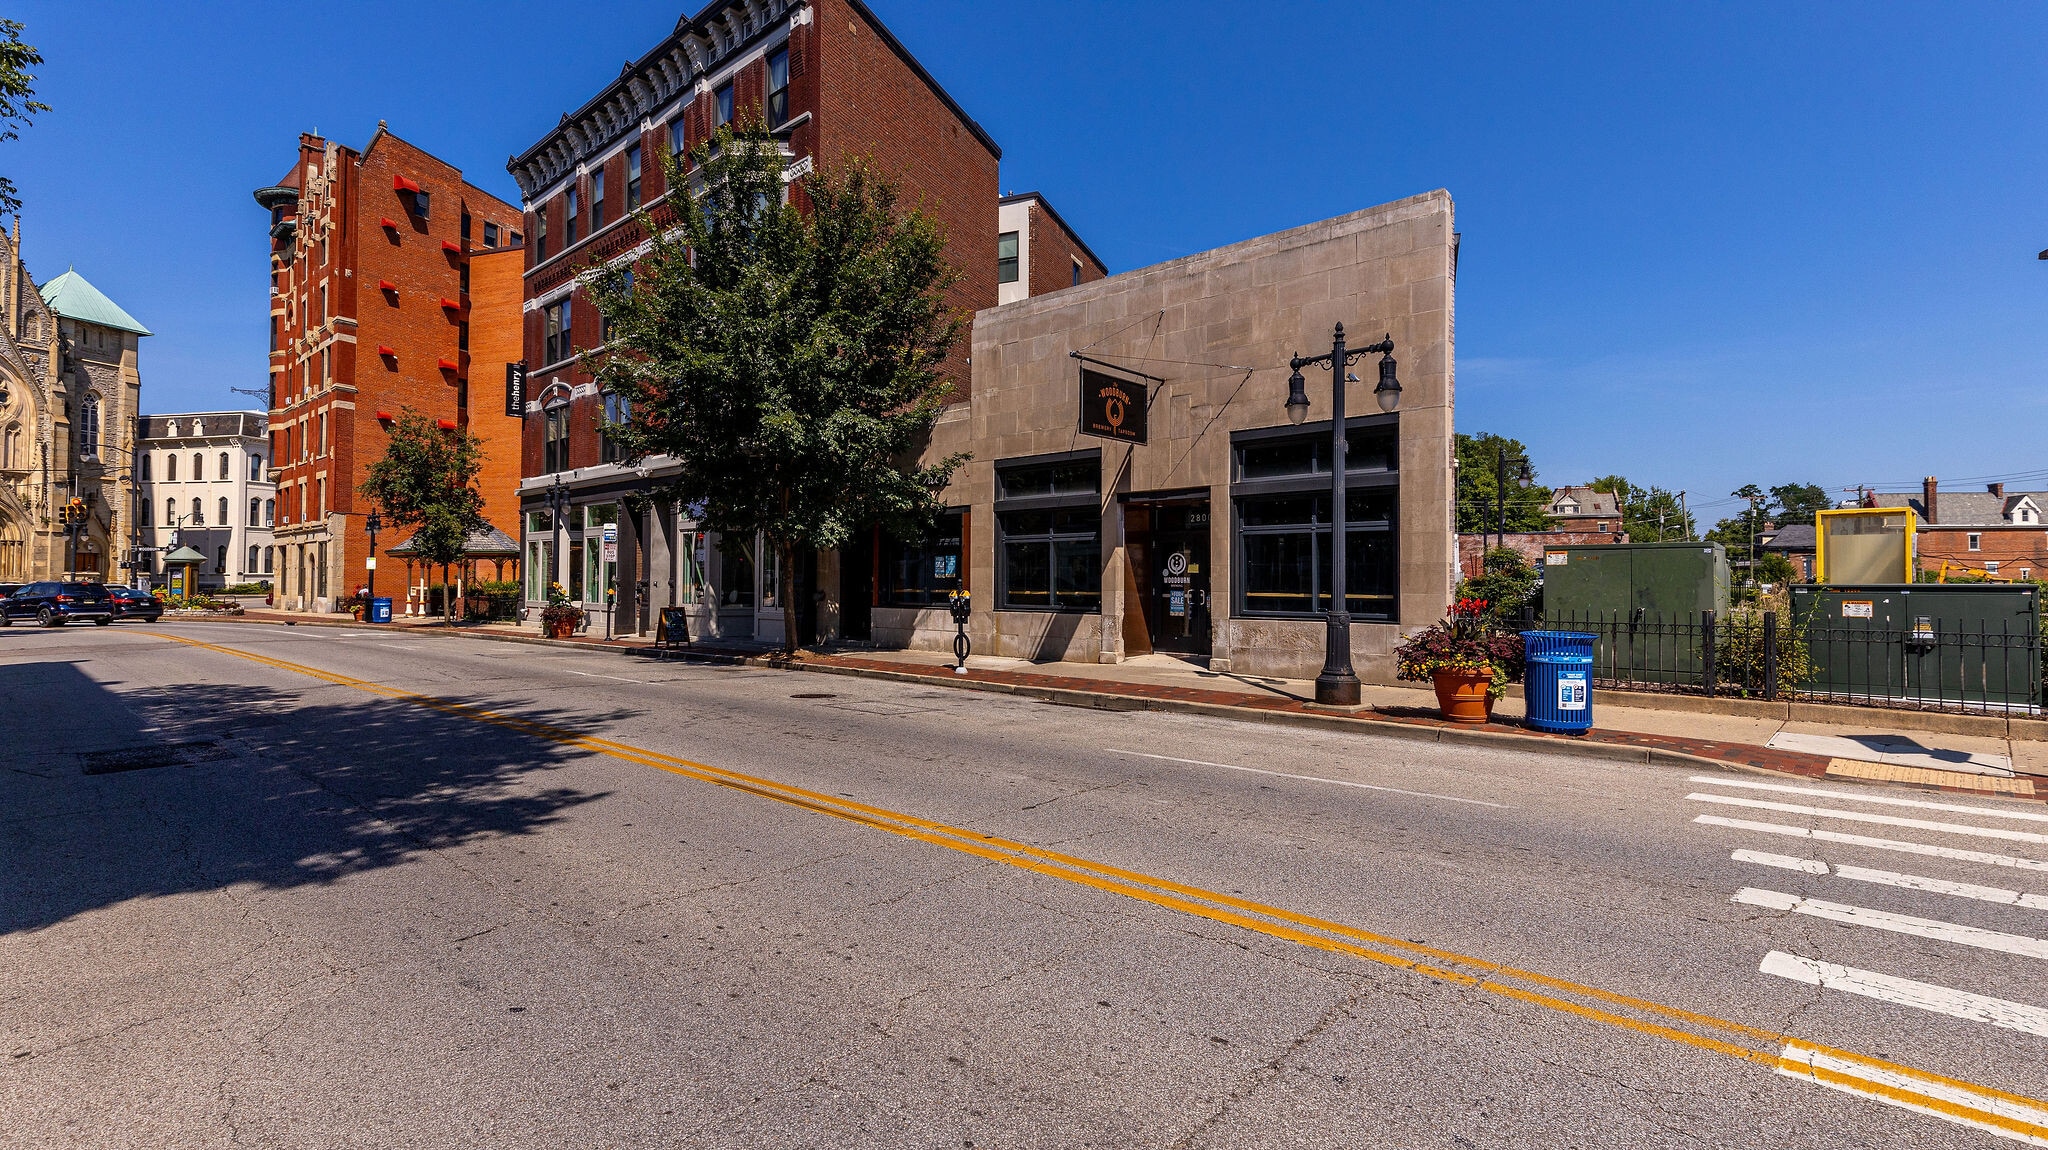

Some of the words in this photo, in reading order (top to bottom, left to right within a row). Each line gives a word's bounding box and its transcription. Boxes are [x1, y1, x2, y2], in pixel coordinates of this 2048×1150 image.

[511, 370, 522, 410] thehenry
[1100, 387, 1130, 406] WOODBURN
[1170, 597, 1184, 605] SALE
